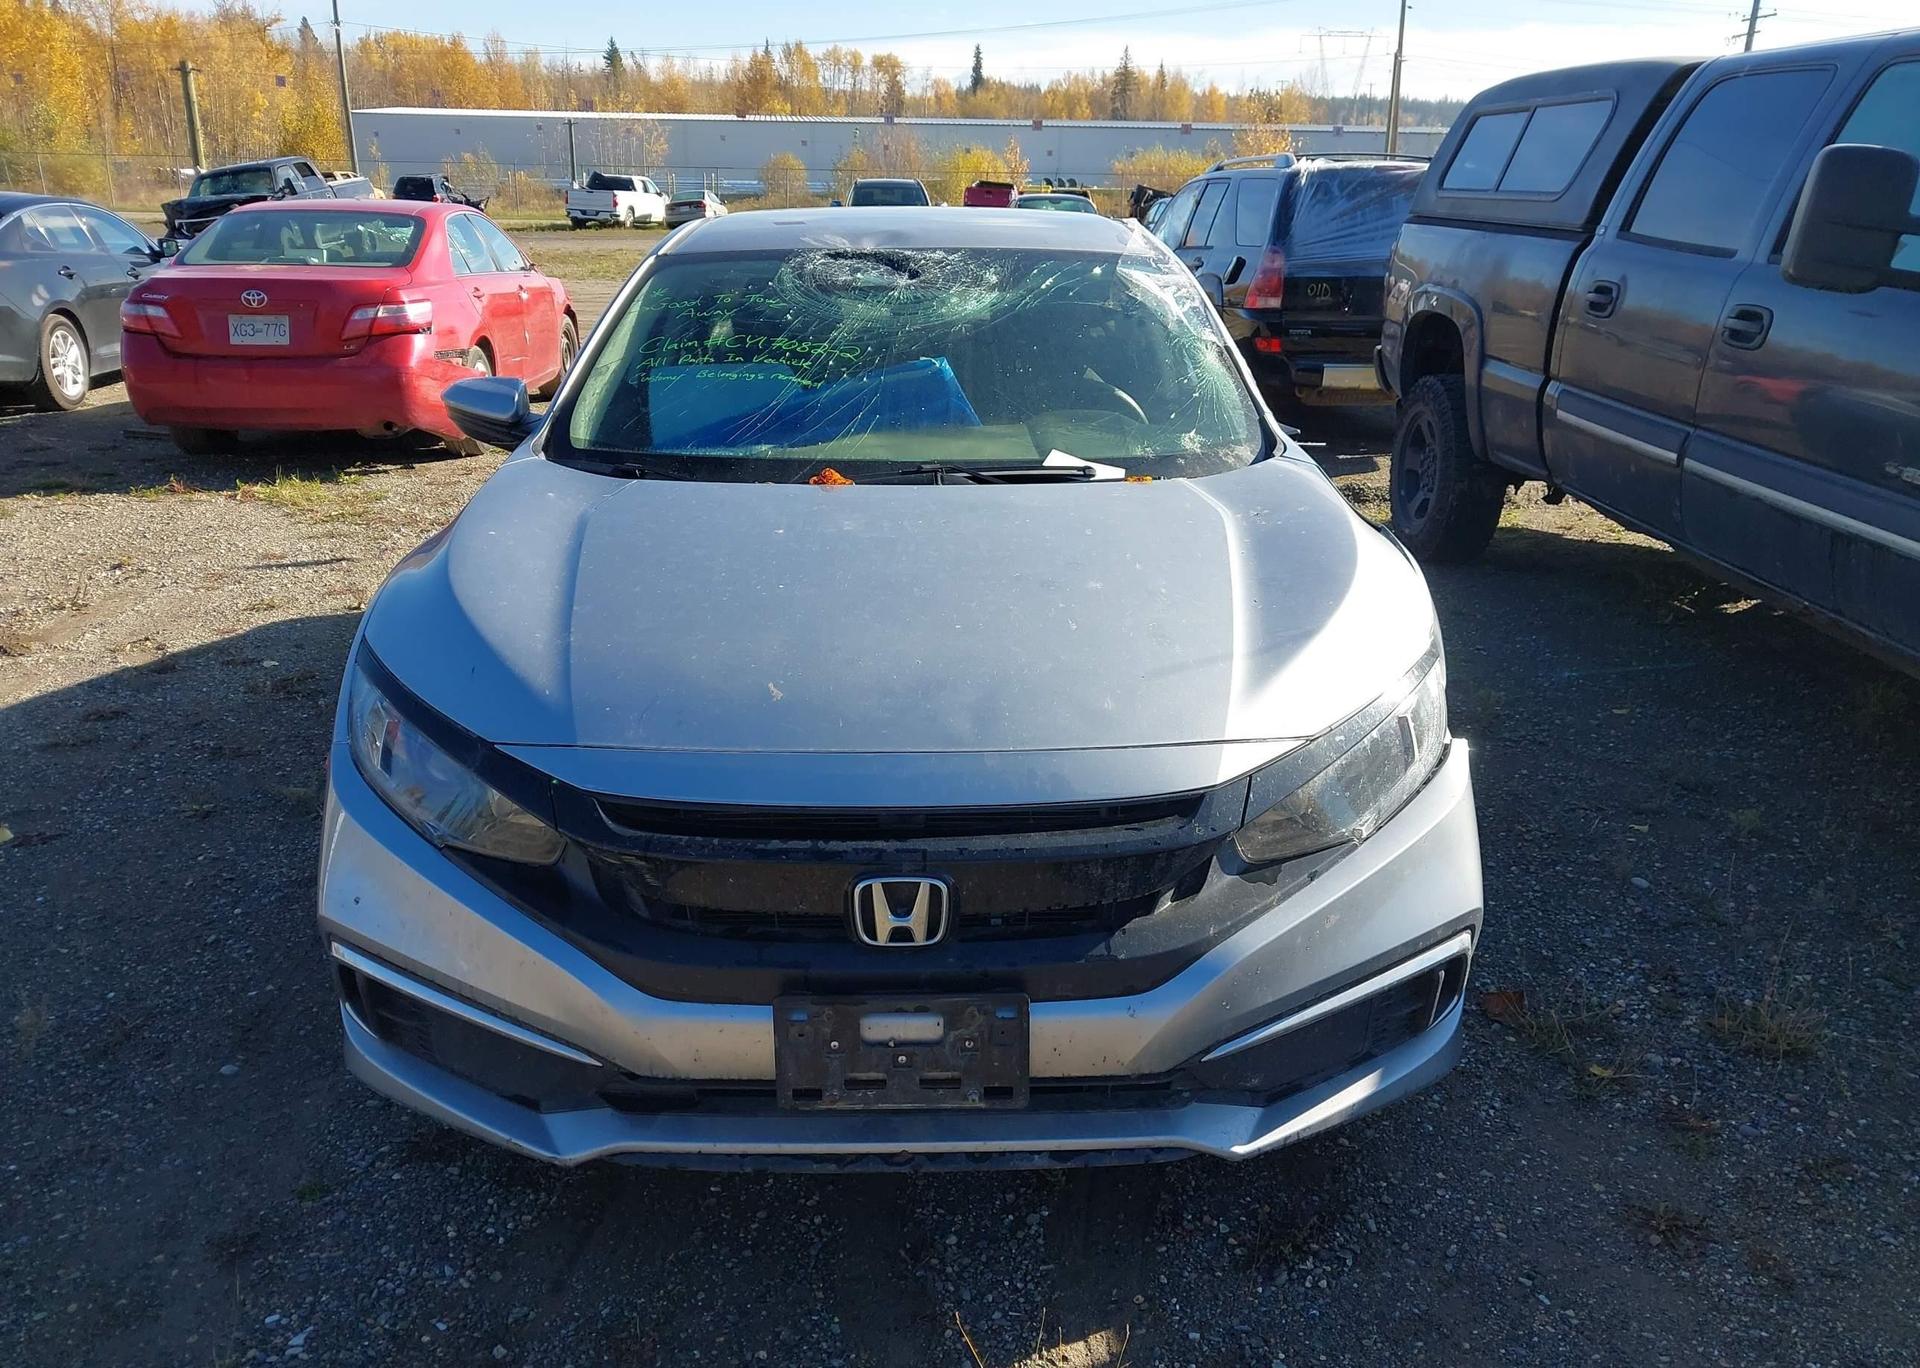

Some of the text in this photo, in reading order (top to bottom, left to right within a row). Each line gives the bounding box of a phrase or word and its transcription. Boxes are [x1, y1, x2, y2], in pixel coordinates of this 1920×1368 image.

[651, 294, 783, 311] Good To Tow
[676, 308, 737, 321] Away
[639, 336, 698, 354] Claim
[636, 356, 668, 370] All
[678, 354, 715, 365] Parts
[723, 353, 745, 362] In
